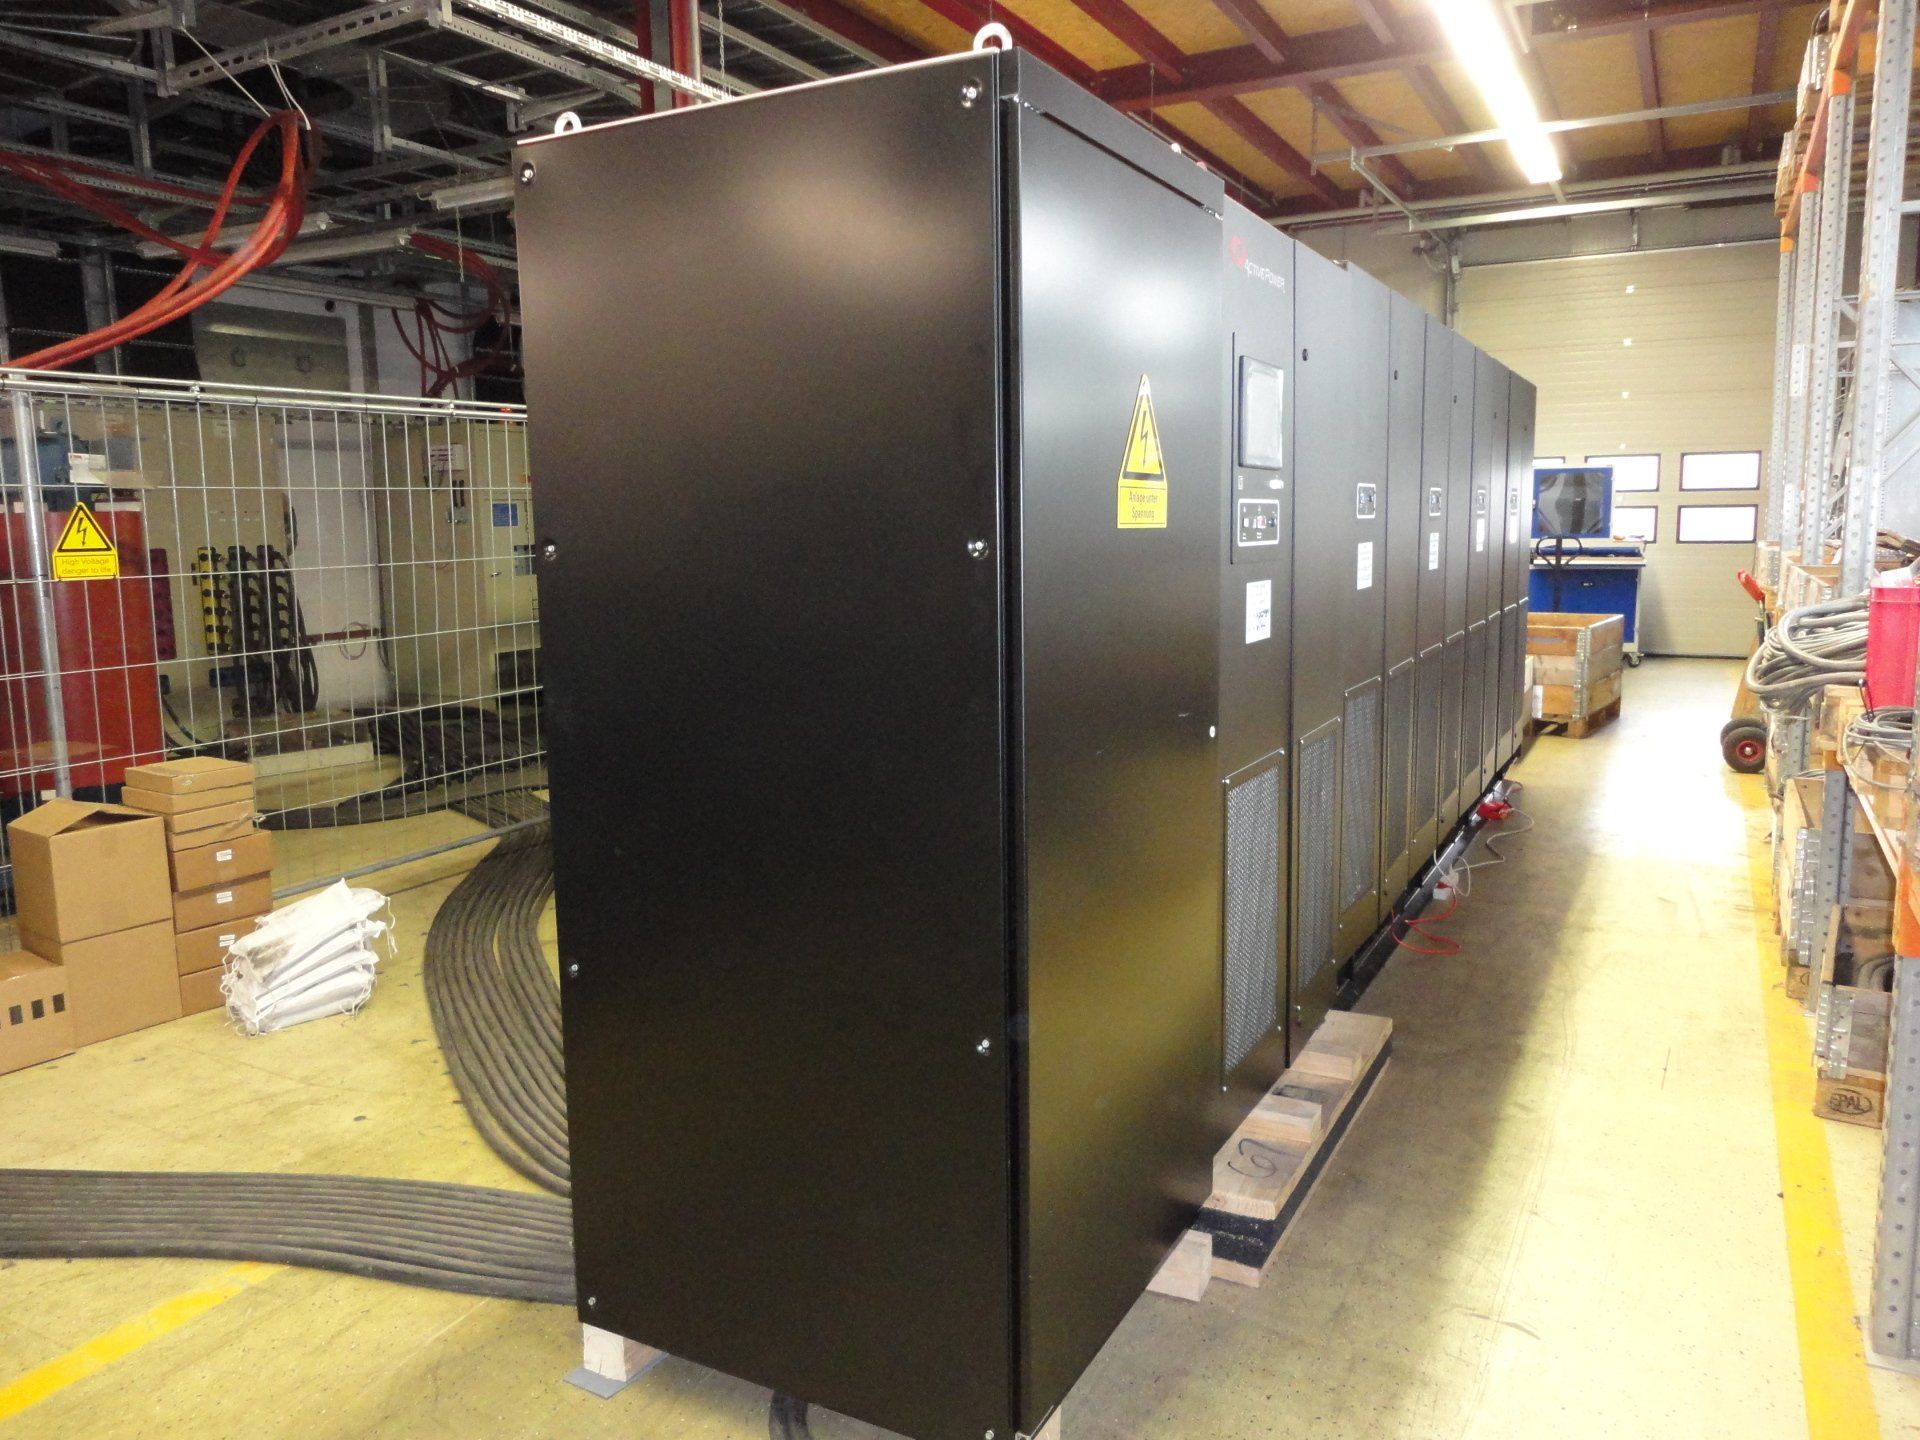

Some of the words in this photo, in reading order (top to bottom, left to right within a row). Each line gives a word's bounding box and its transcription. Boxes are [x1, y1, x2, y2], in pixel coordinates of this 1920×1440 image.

[1129, 490, 1146, 505] Anlage
[1146, 494, 1158, 503] unter
[1131, 506, 1155, 521] Spannung
[61, 558, 80, 566] High
[81, 558, 110, 566] Voltage
[62, 567, 89, 576] danger
